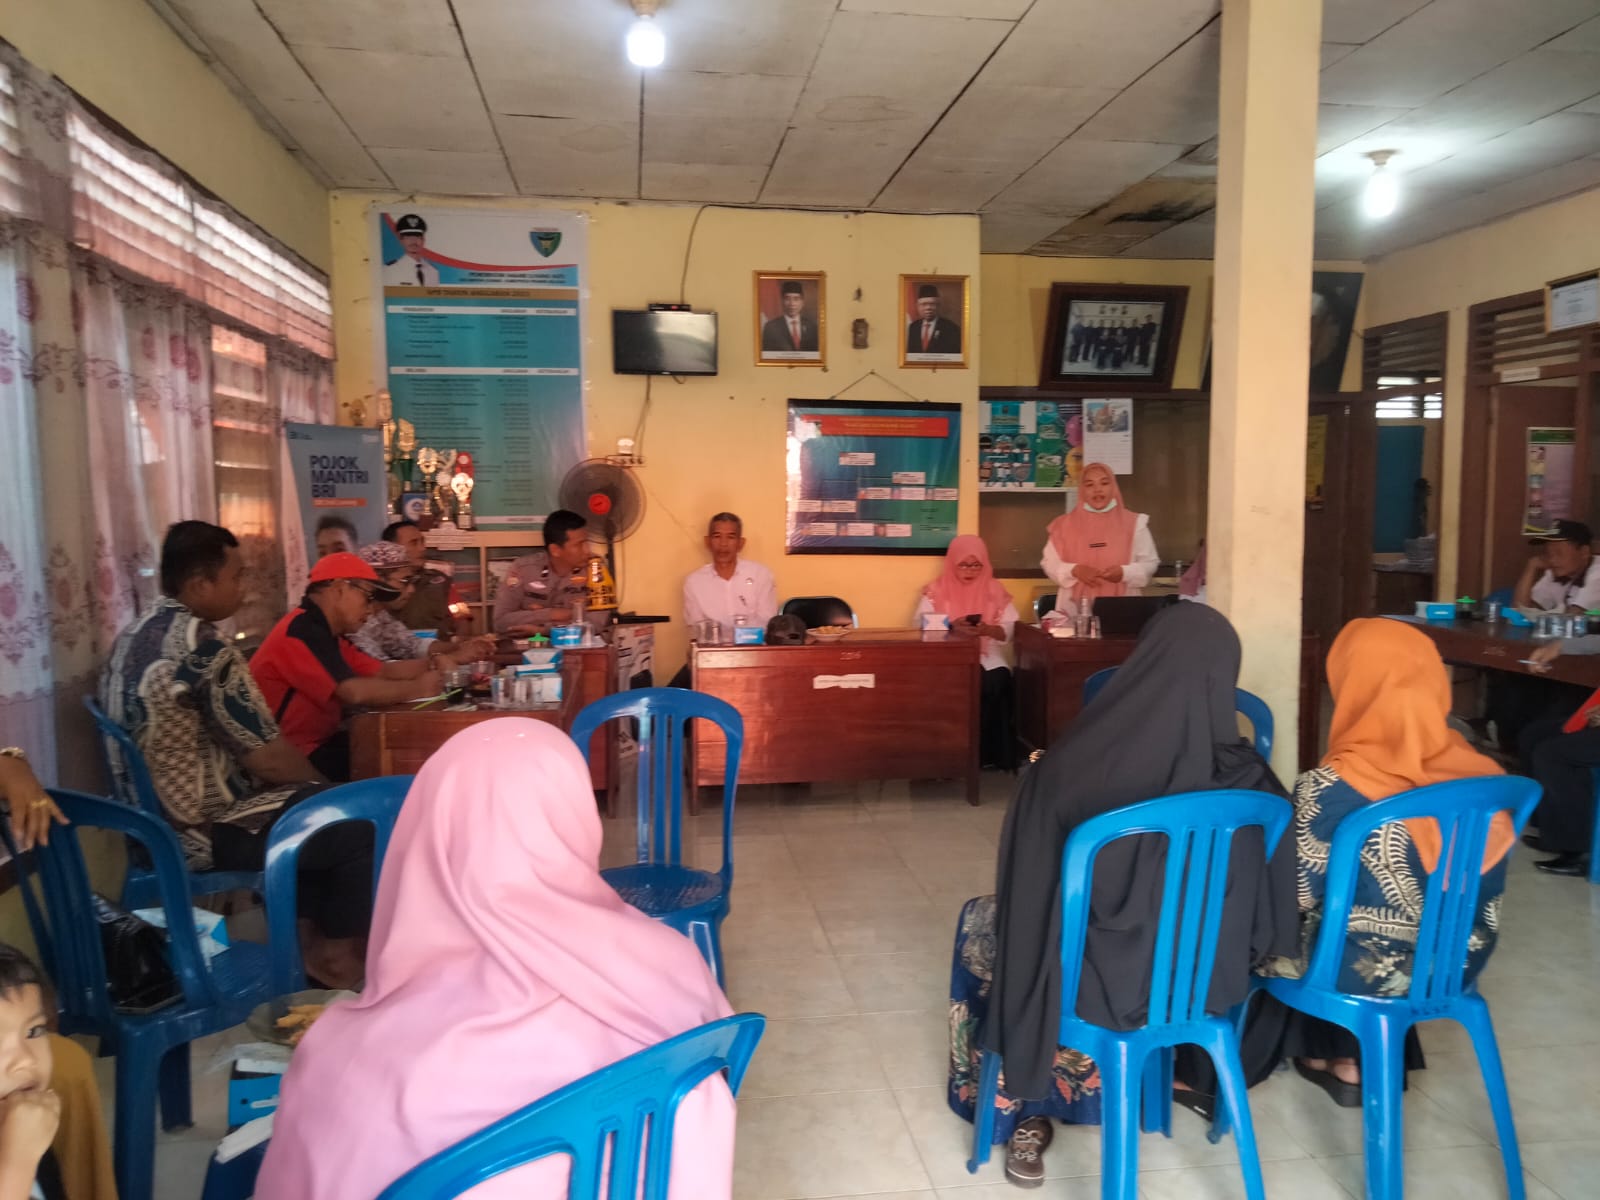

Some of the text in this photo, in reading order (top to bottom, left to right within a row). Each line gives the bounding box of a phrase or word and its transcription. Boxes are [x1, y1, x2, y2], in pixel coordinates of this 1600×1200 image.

[310, 455, 359, 470] POJOK
[311, 470, 369, 484] MANTRI
[311, 484, 337, 498] BRI
